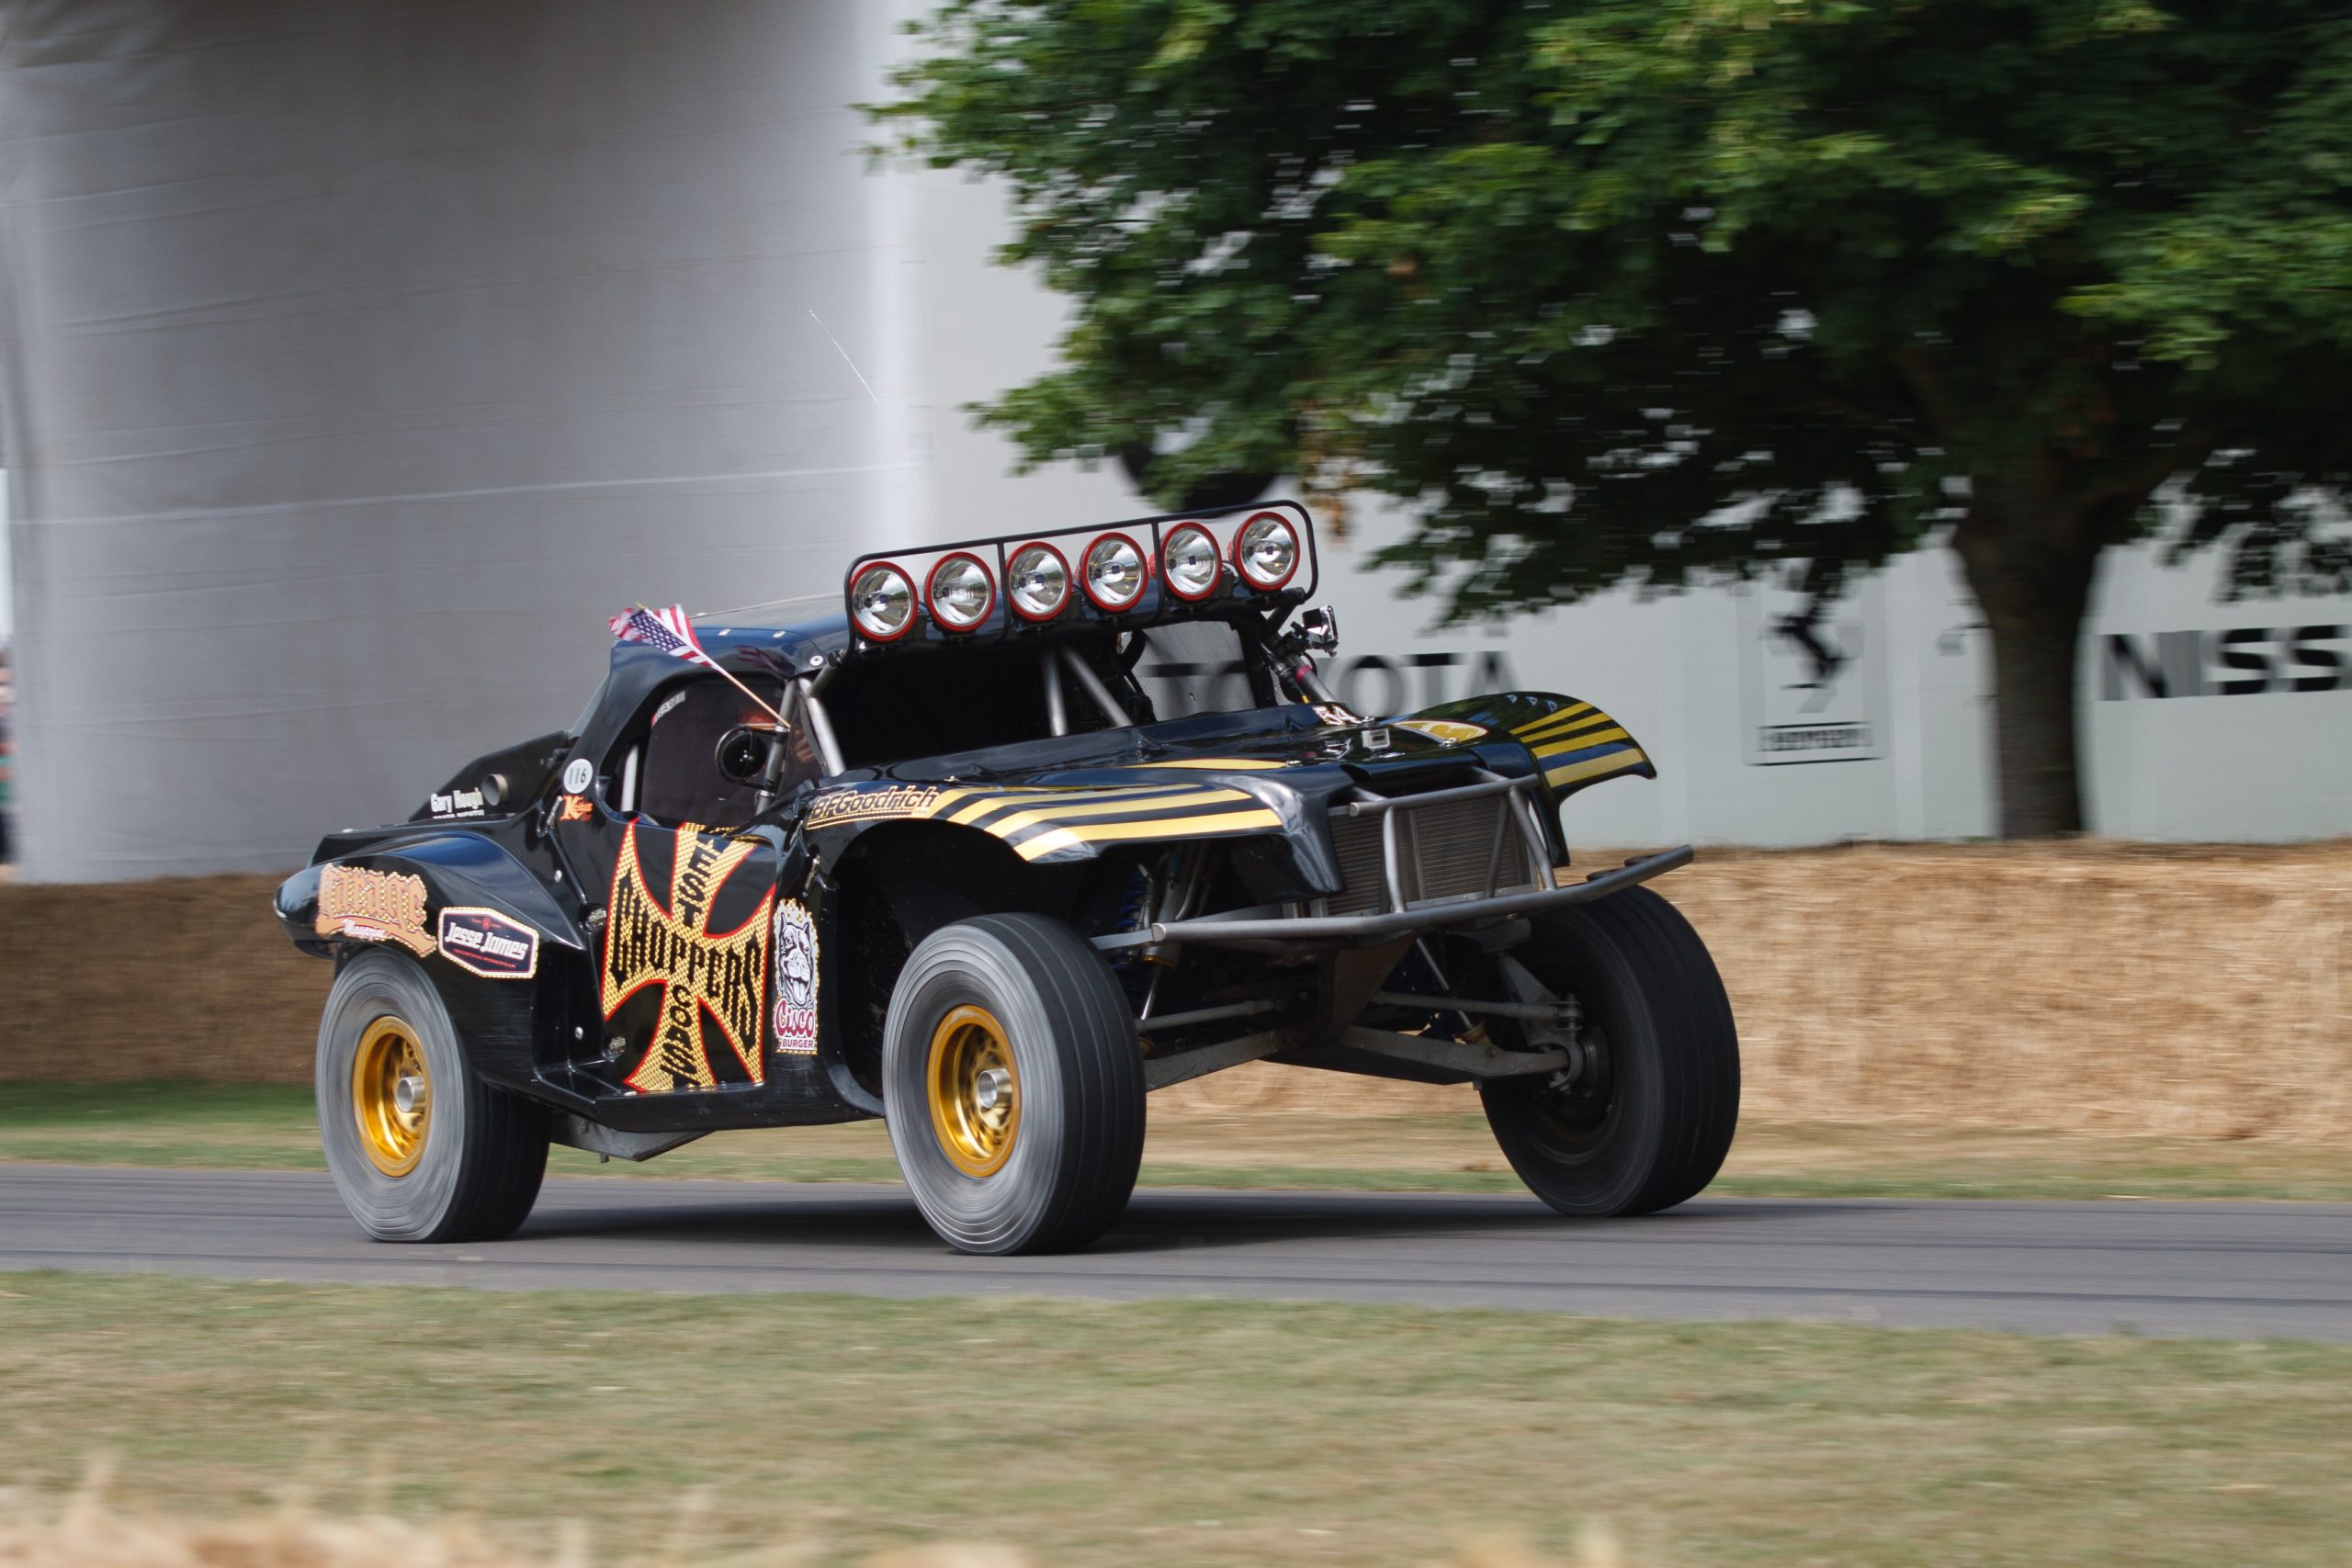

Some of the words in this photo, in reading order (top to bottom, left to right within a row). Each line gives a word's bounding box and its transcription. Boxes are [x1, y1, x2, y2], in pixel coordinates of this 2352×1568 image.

[1144, 650, 1521, 719] TOOTA
[569, 768, 586, 784] 116
[810, 785, 939, 820] BFGoodrich
[445, 921, 483, 949] Jesse
[480, 931, 529, 960] James
[610, 868, 762, 1056] CHOPPERS
[660, 985, 700, 1088] COAST
[775, 998, 816, 1037] Cisco
[782, 1039, 814, 1049] BURGER
